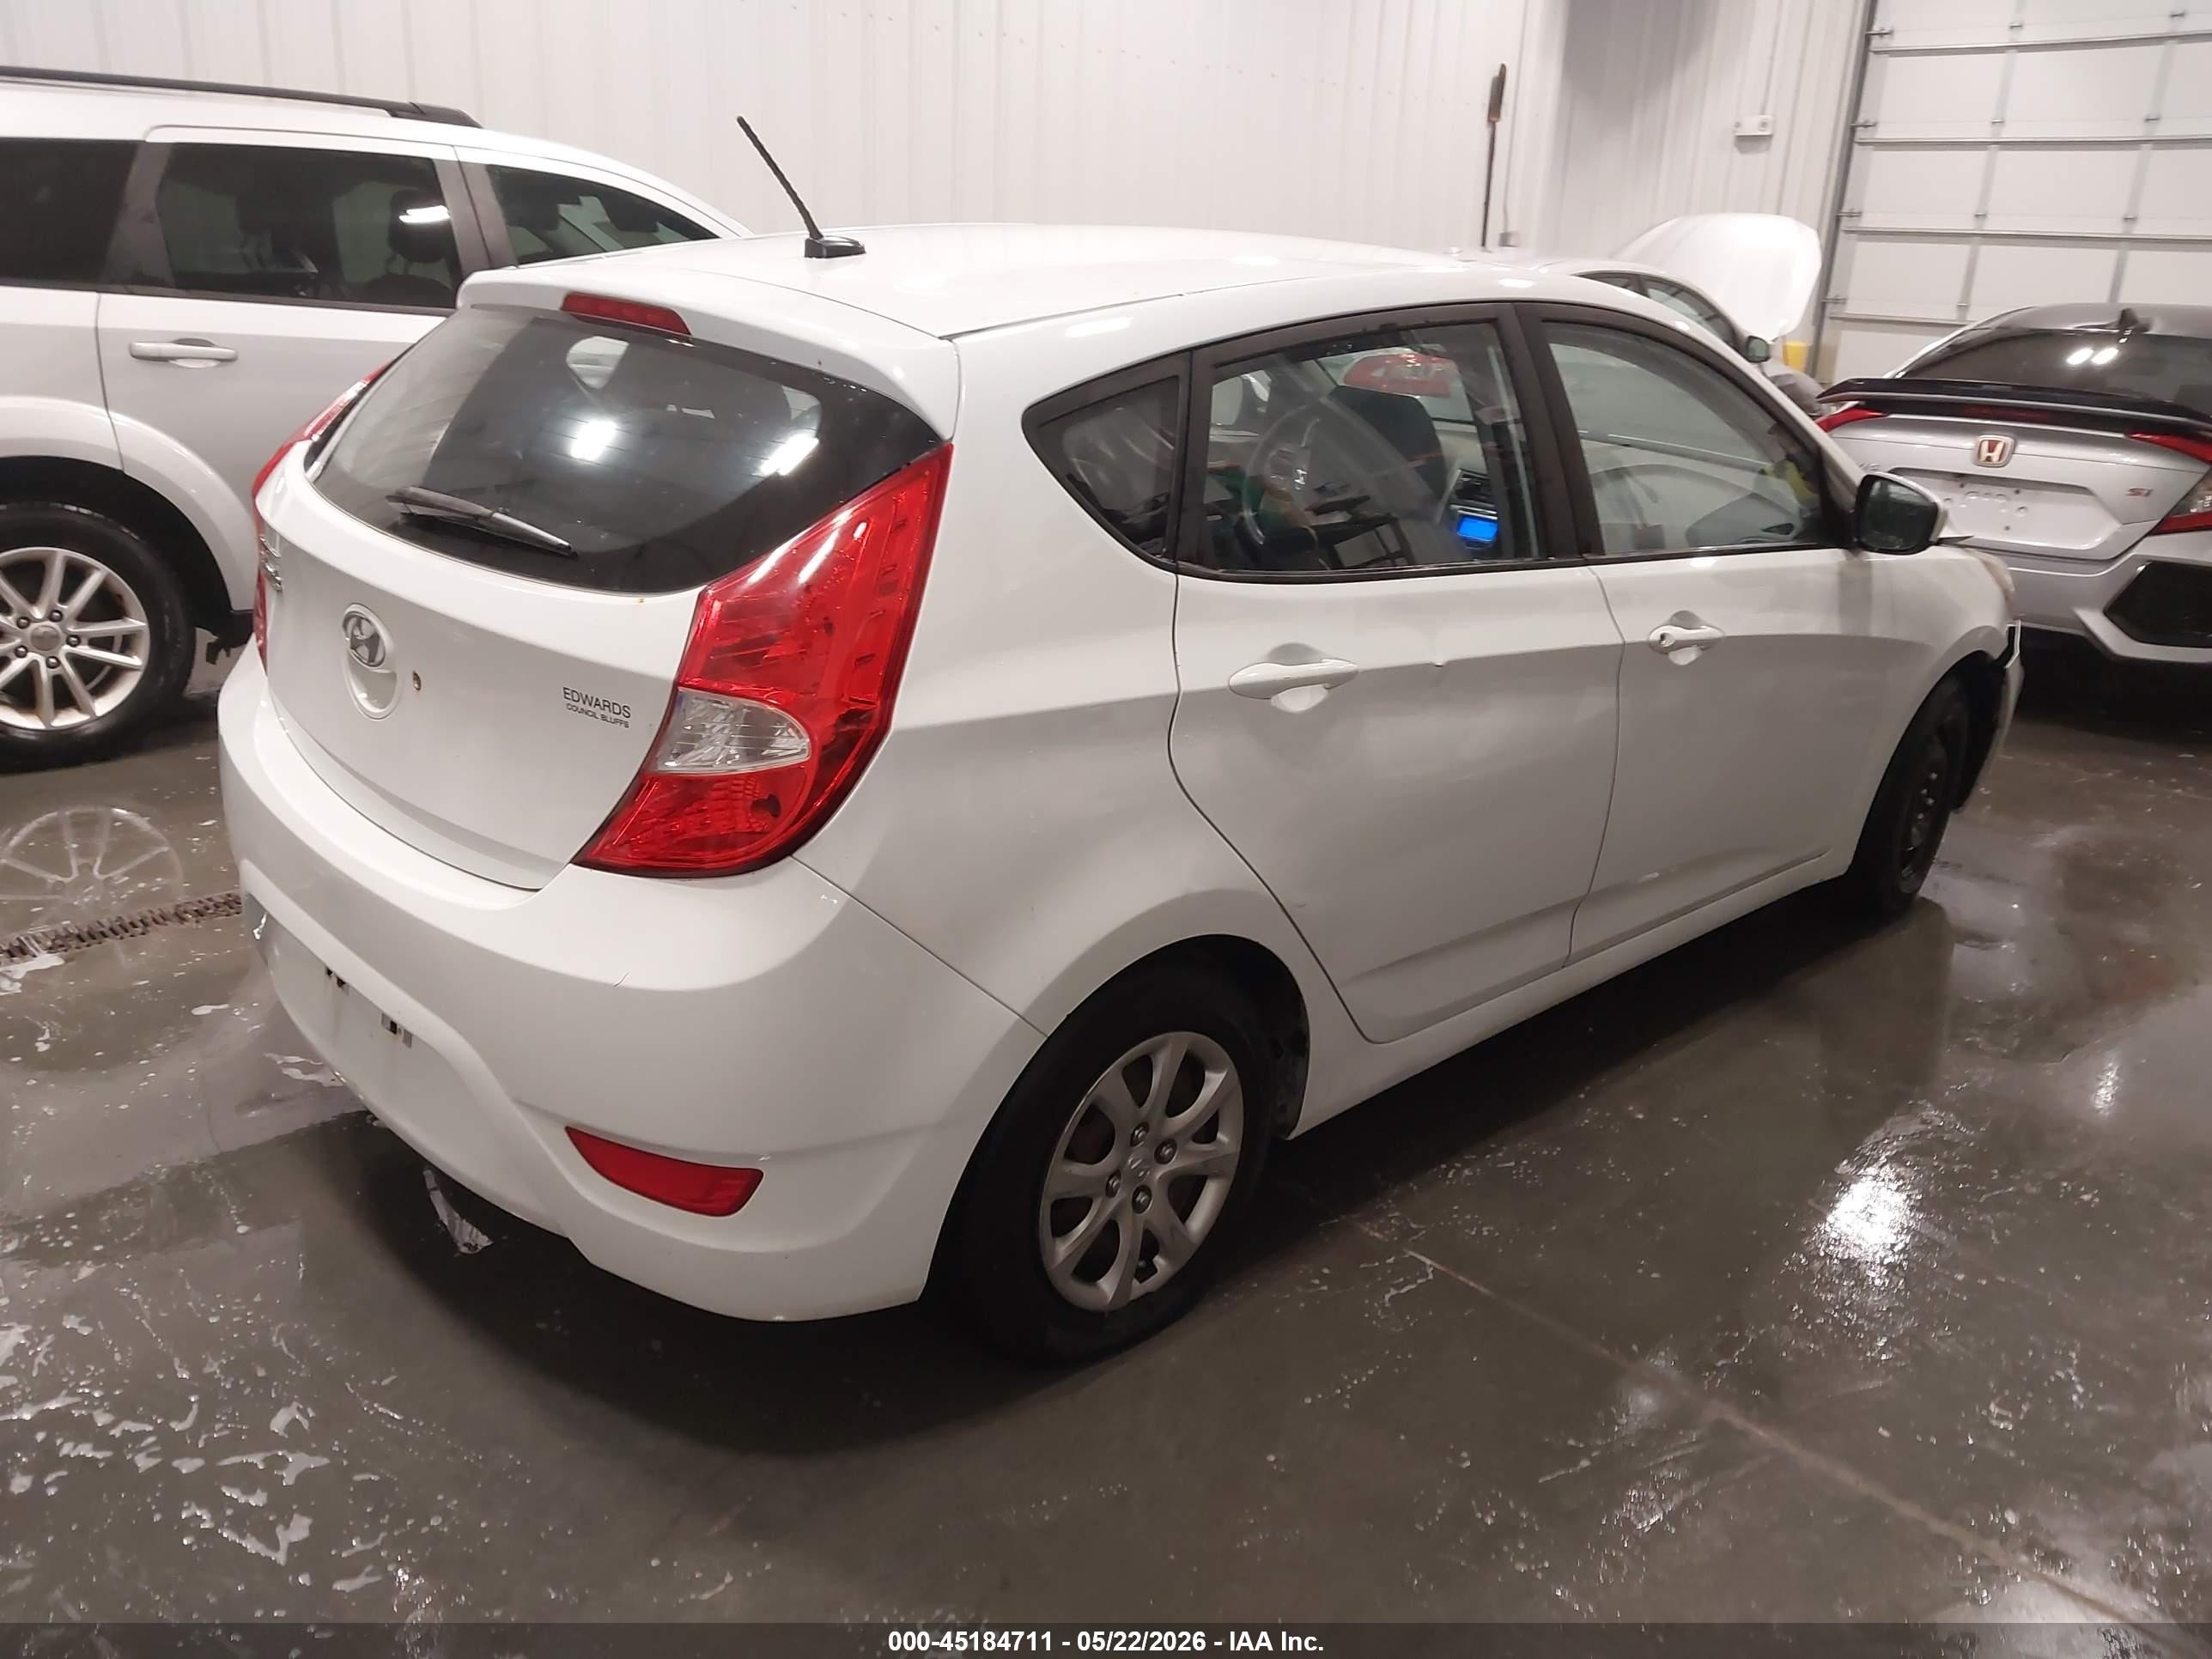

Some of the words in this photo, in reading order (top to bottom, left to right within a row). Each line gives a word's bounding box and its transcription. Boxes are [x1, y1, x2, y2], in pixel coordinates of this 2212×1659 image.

[562, 686, 631, 719] EDWARDS
[566, 702, 599, 720] COUNCIL
[600, 714, 629, 729] BLUFFS
